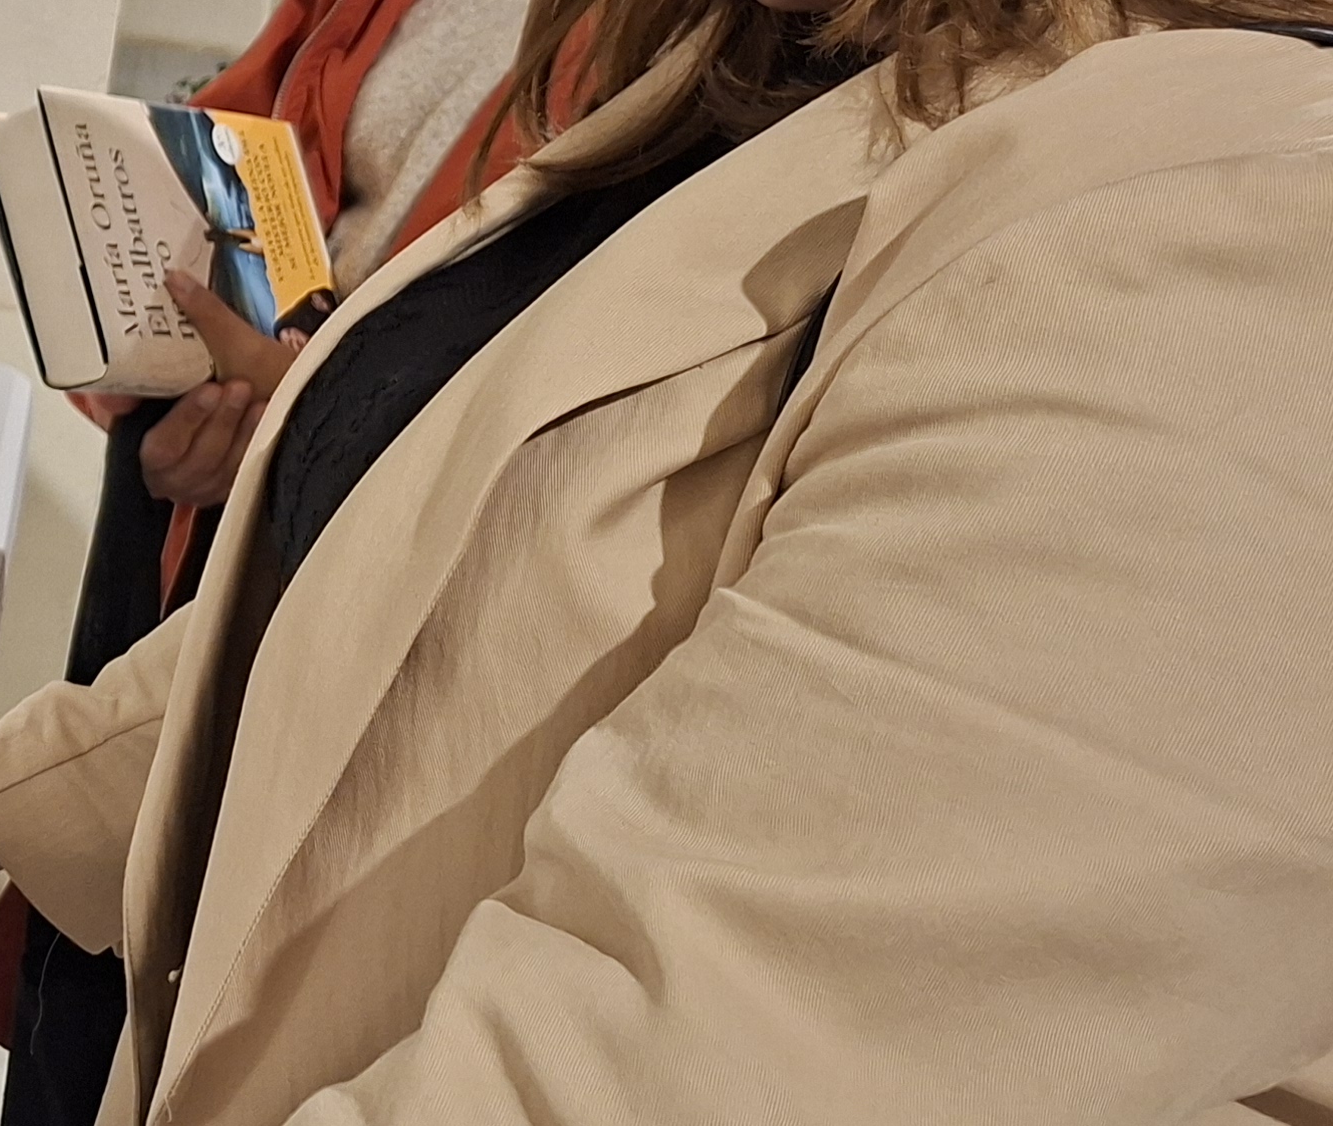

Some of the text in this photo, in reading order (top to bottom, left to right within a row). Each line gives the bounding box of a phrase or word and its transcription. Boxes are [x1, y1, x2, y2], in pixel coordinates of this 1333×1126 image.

[75, 123, 143, 338] María Oruña
[109, 148, 172, 338] El albatros
